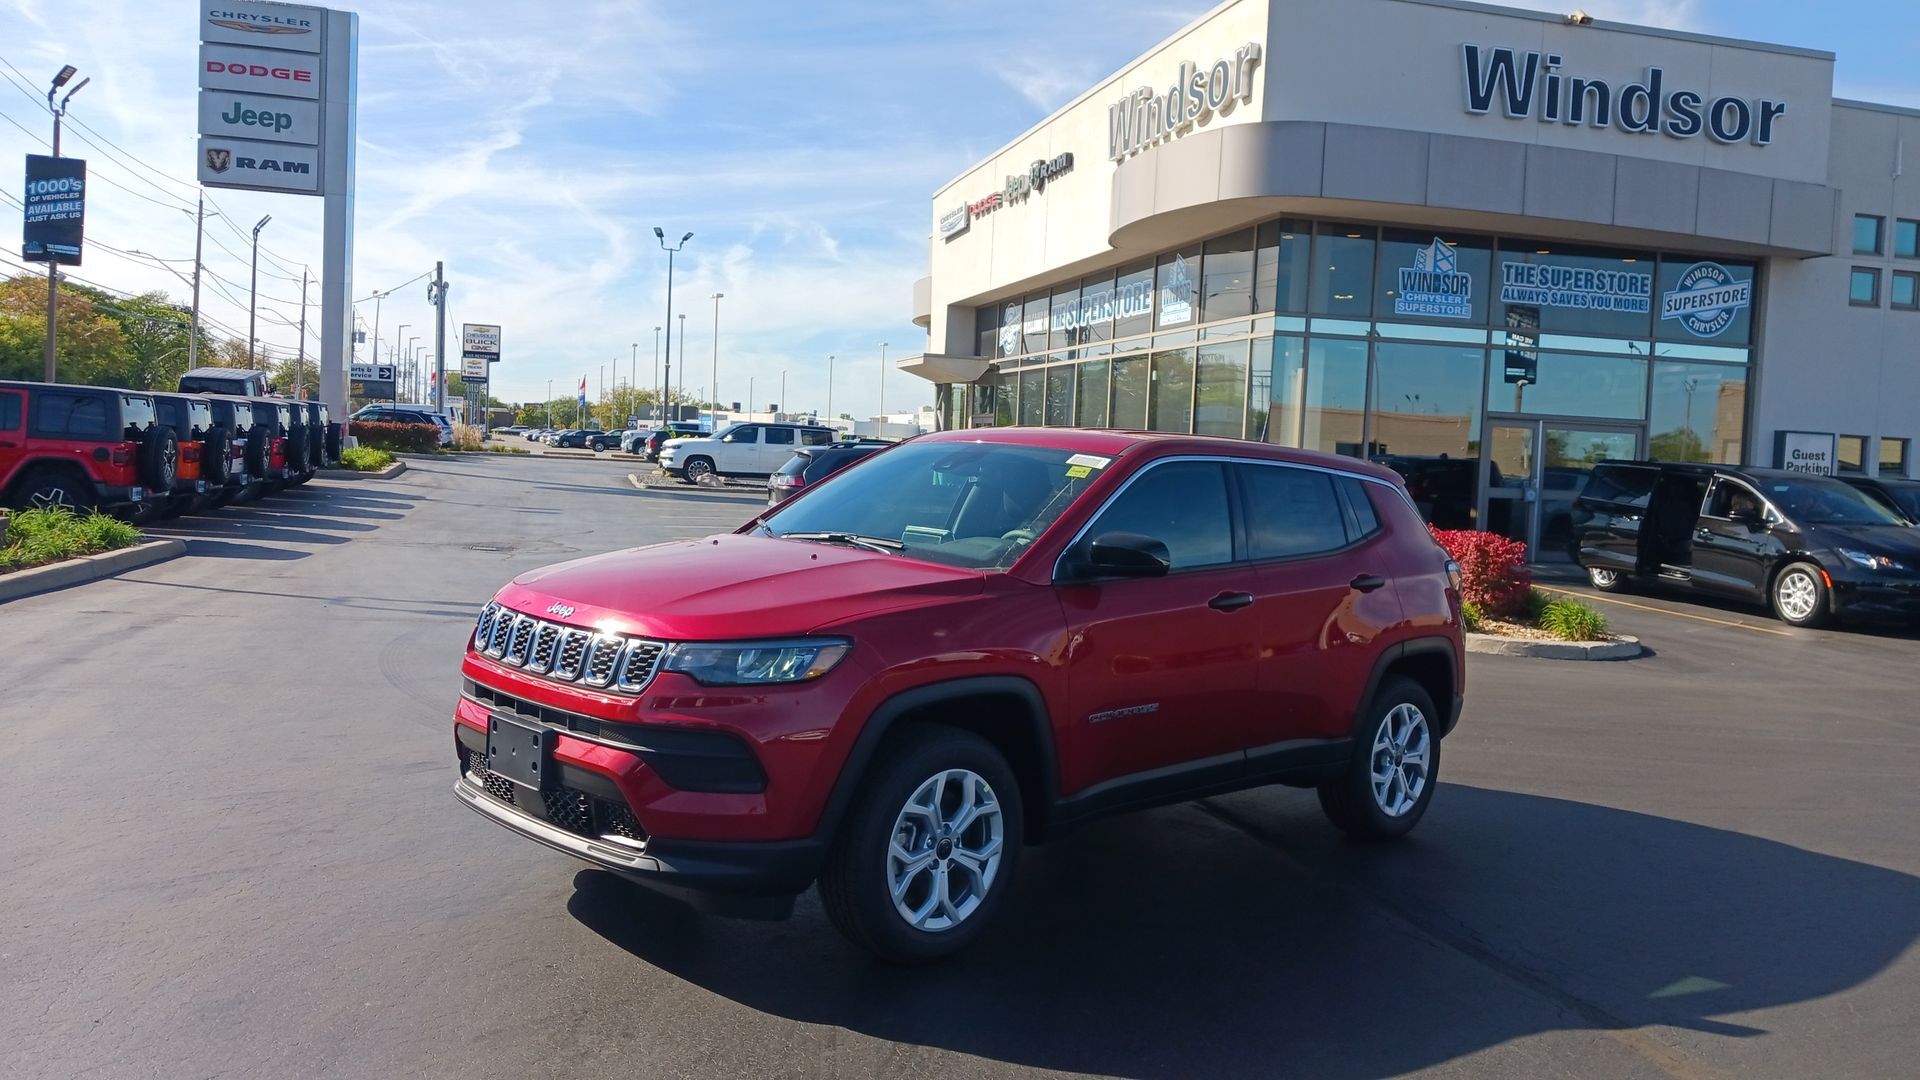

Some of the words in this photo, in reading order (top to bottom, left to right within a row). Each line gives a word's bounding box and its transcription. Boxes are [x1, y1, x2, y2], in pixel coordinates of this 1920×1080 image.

[209, 9, 311, 28] CHRYSLER
[206, 61, 312, 82] DODGE
[1107, 42, 1262, 162] Windsor
[1459, 42, 1786, 147] Windsor
[221, 101, 293, 133] Jeep
[235, 156, 310, 175] RAM
[1040, 152, 1074, 179] RAM
[29, 179, 82, 194] 1000's
[28, 203, 82, 214] AVAILABLE
[968, 191, 1004, 217] DODGE
[1401, 271, 1469, 296] WINDSOR
[1504, 264, 1536, 285] THE
[1538, 266, 1650, 295] SUPERSTORE
[1684, 267, 1725, 288] WINDSOR
[1051, 303, 1066, 331] THE
[1066, 281, 1153, 330] SUPERSTORE
[1397, 302, 1469, 316] SUPERSTORE
[1406, 293, 1462, 304] CHRYSLER
[1501, 287, 1548, 304] ALWAYS
[1550, 291, 1588, 307] SAVES
[1589, 294, 1612, 309] YOU
[1613, 296, 1649, 312] MORE!
[1665, 287, 1748, 313] SUPERSTORE
[1688, 311, 1730, 333] CHRYSLER
[465, 338, 497, 346] BUICK
[1792, 449, 1825, 460] Guest
[1786, 462, 1829, 474] Parking
[547, 601, 576, 619] Jeep
